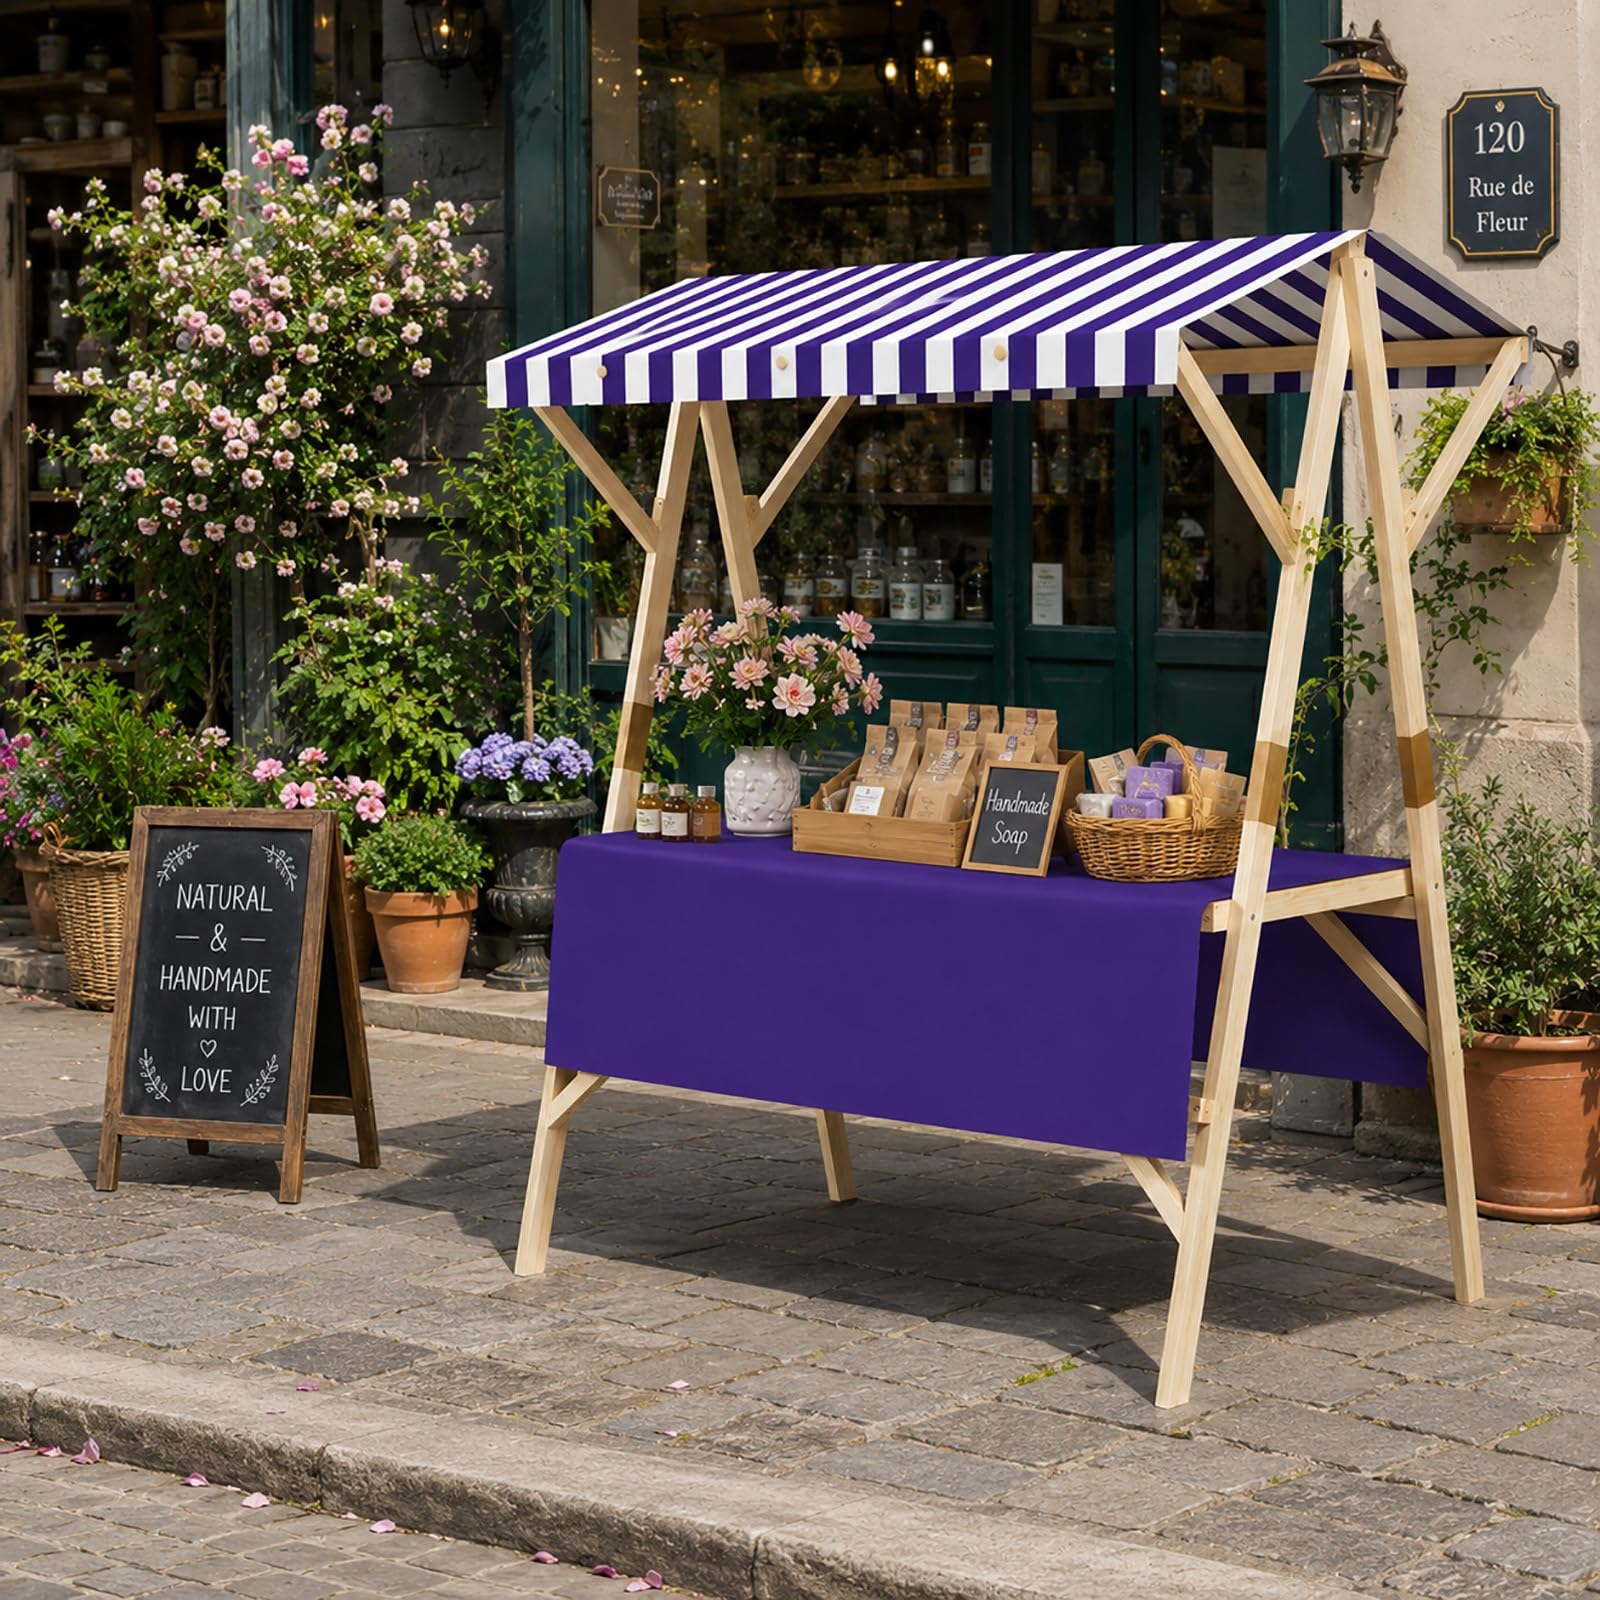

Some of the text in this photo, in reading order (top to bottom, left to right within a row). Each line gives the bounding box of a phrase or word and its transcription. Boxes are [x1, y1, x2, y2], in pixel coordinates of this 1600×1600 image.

[1474, 121, 1525, 155] 120
[1468, 174, 1534, 198] Rue de
[1476, 211, 1529, 233] Fleur
[985, 788, 1050, 815] Handmade
[991, 820, 1028, 854] Soap
[176, 883, 273, 912] NATURAL
[210, 923, 227, 952] &
[159, 964, 272, 994] HANDMADE
[188, 1005, 236, 1031] WITH
[181, 1066, 232, 1093] LOVE
